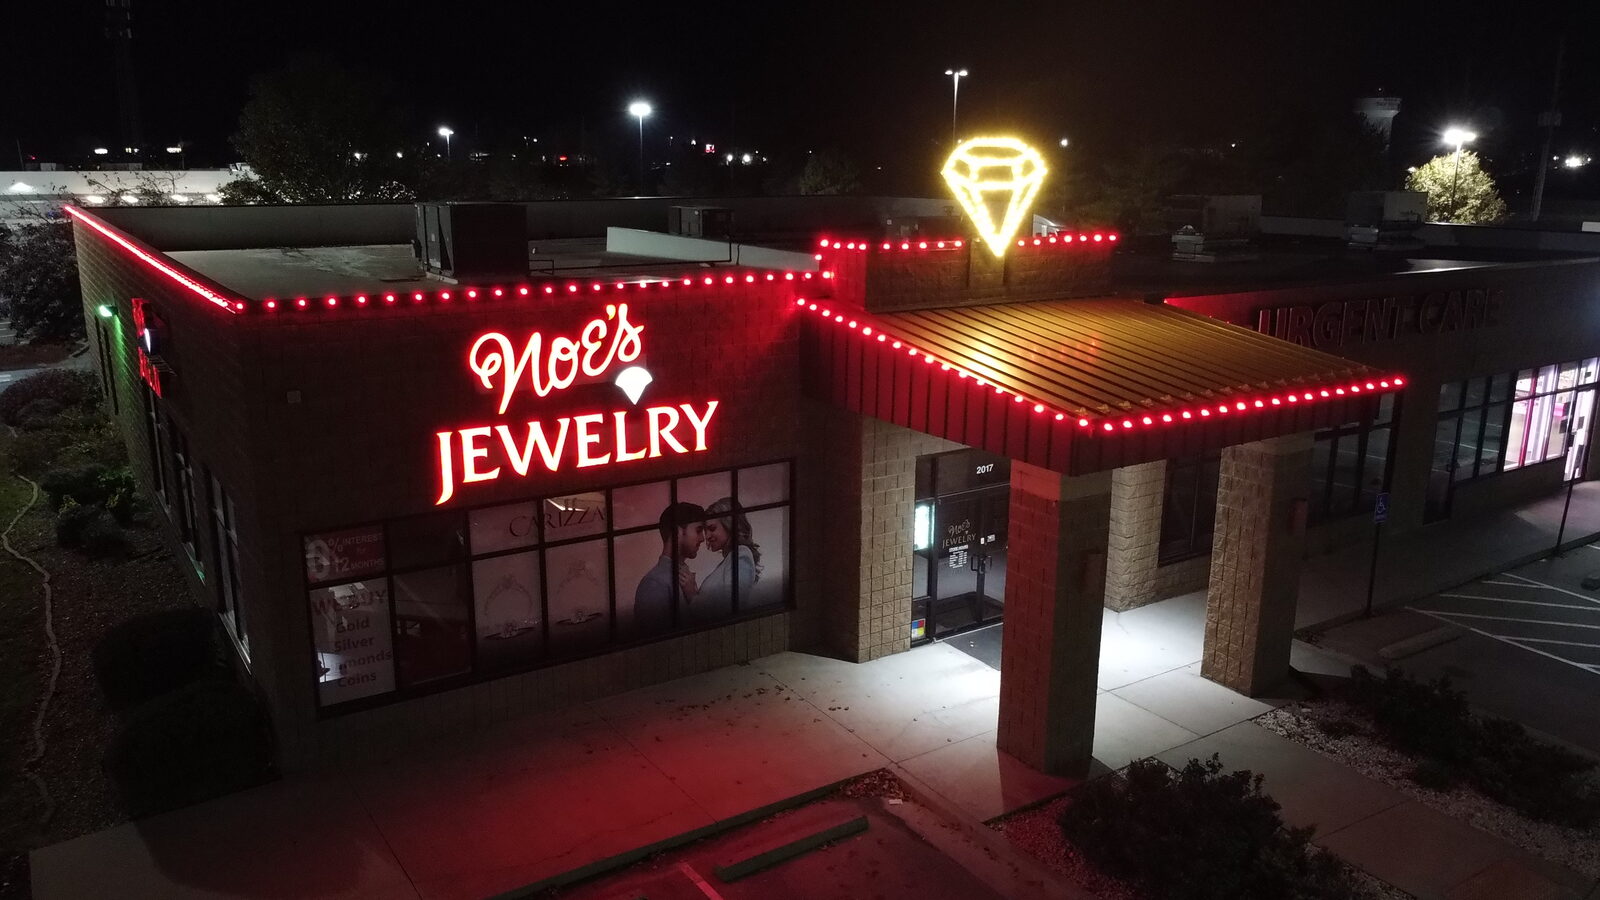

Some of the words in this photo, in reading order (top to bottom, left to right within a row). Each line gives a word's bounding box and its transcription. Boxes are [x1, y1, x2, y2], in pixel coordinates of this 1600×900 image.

[1257, 297, 1411, 346] URGENT
[1419, 286, 1503, 334] CARE
[434, 400, 719, 505] JEWELRY
[976, 463, 994, 475] 2017
[509, 505, 605, 537] CARIZZA
[342, 532, 383, 545] INTEREST
[942, 533, 976, 549] JEWELRY
[336, 617, 370, 633] Gold
[334, 637, 376, 652] Silver
[338, 649, 393, 673] monds
[337, 672, 377, 687] Coins
